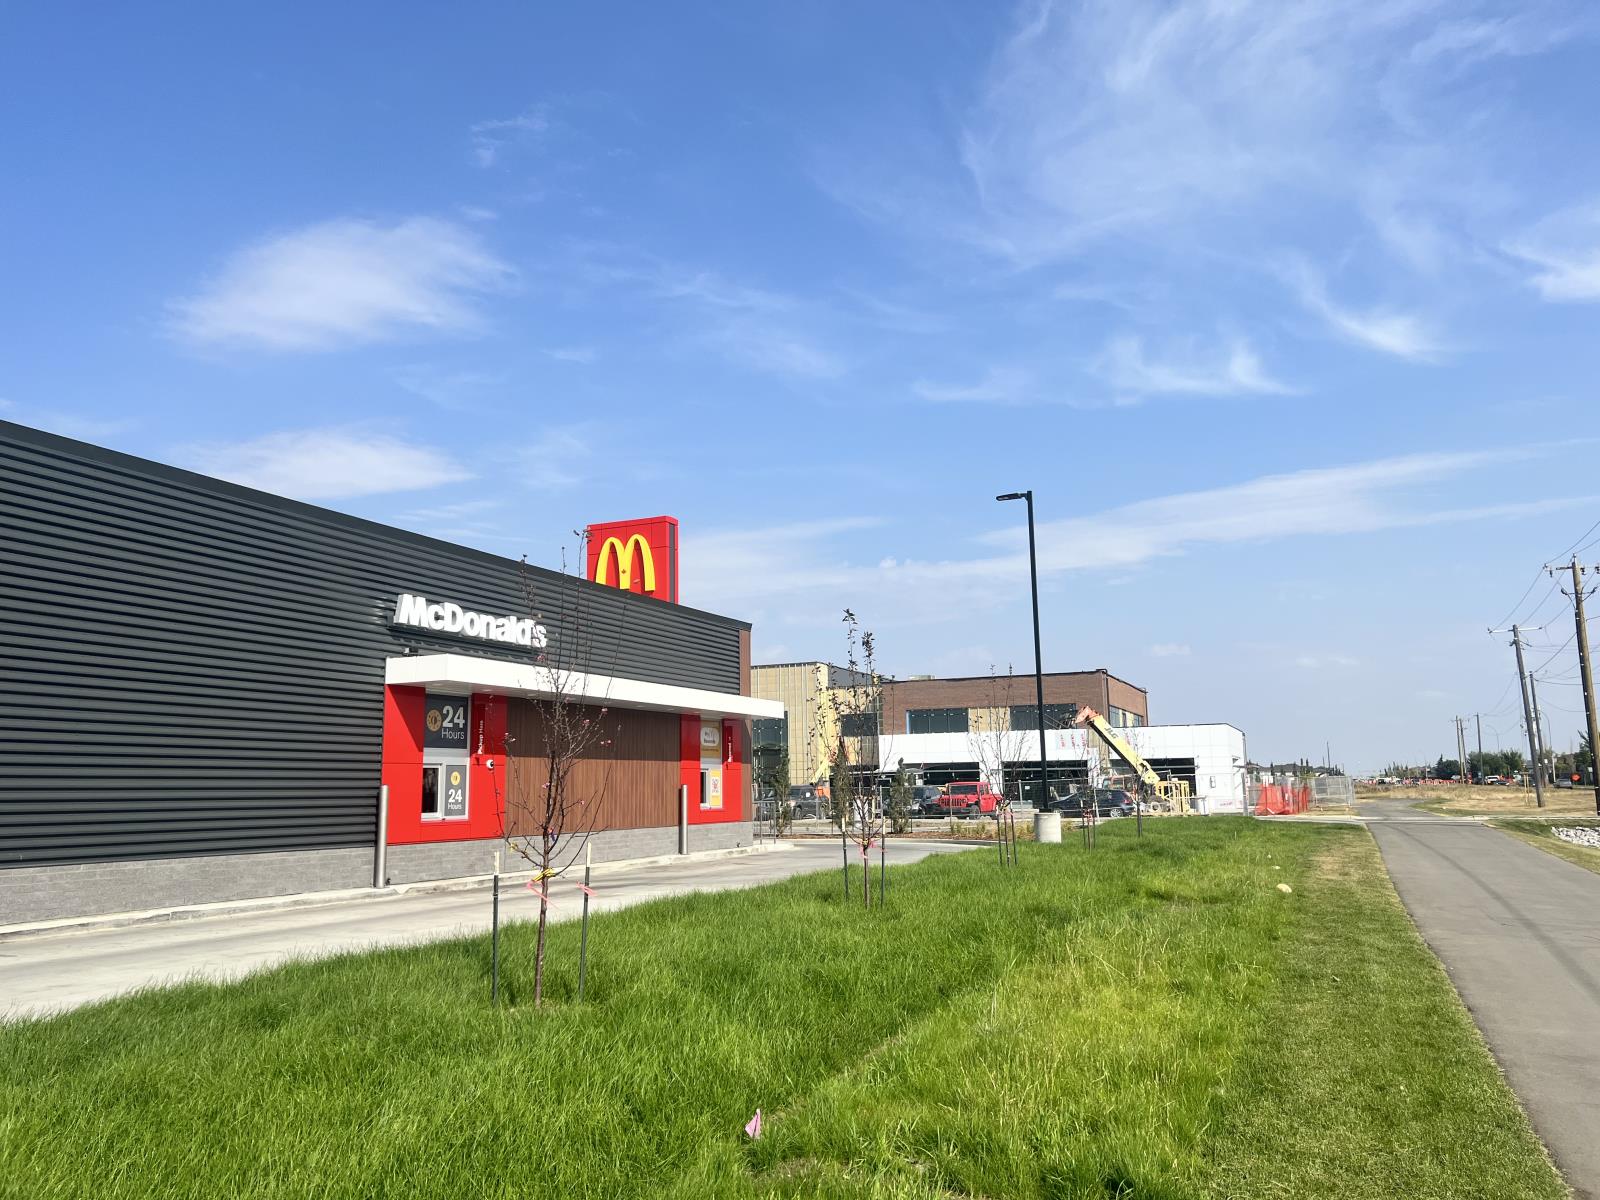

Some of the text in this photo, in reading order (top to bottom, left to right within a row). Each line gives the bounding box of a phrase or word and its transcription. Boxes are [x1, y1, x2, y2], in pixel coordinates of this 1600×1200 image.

[393, 593, 547, 648] McDonald's
[442, 705, 465, 728] 24
[441, 728, 465, 740] Hours
[1104, 727, 1119, 739] JLG
[448, 788, 462, 803] 24
